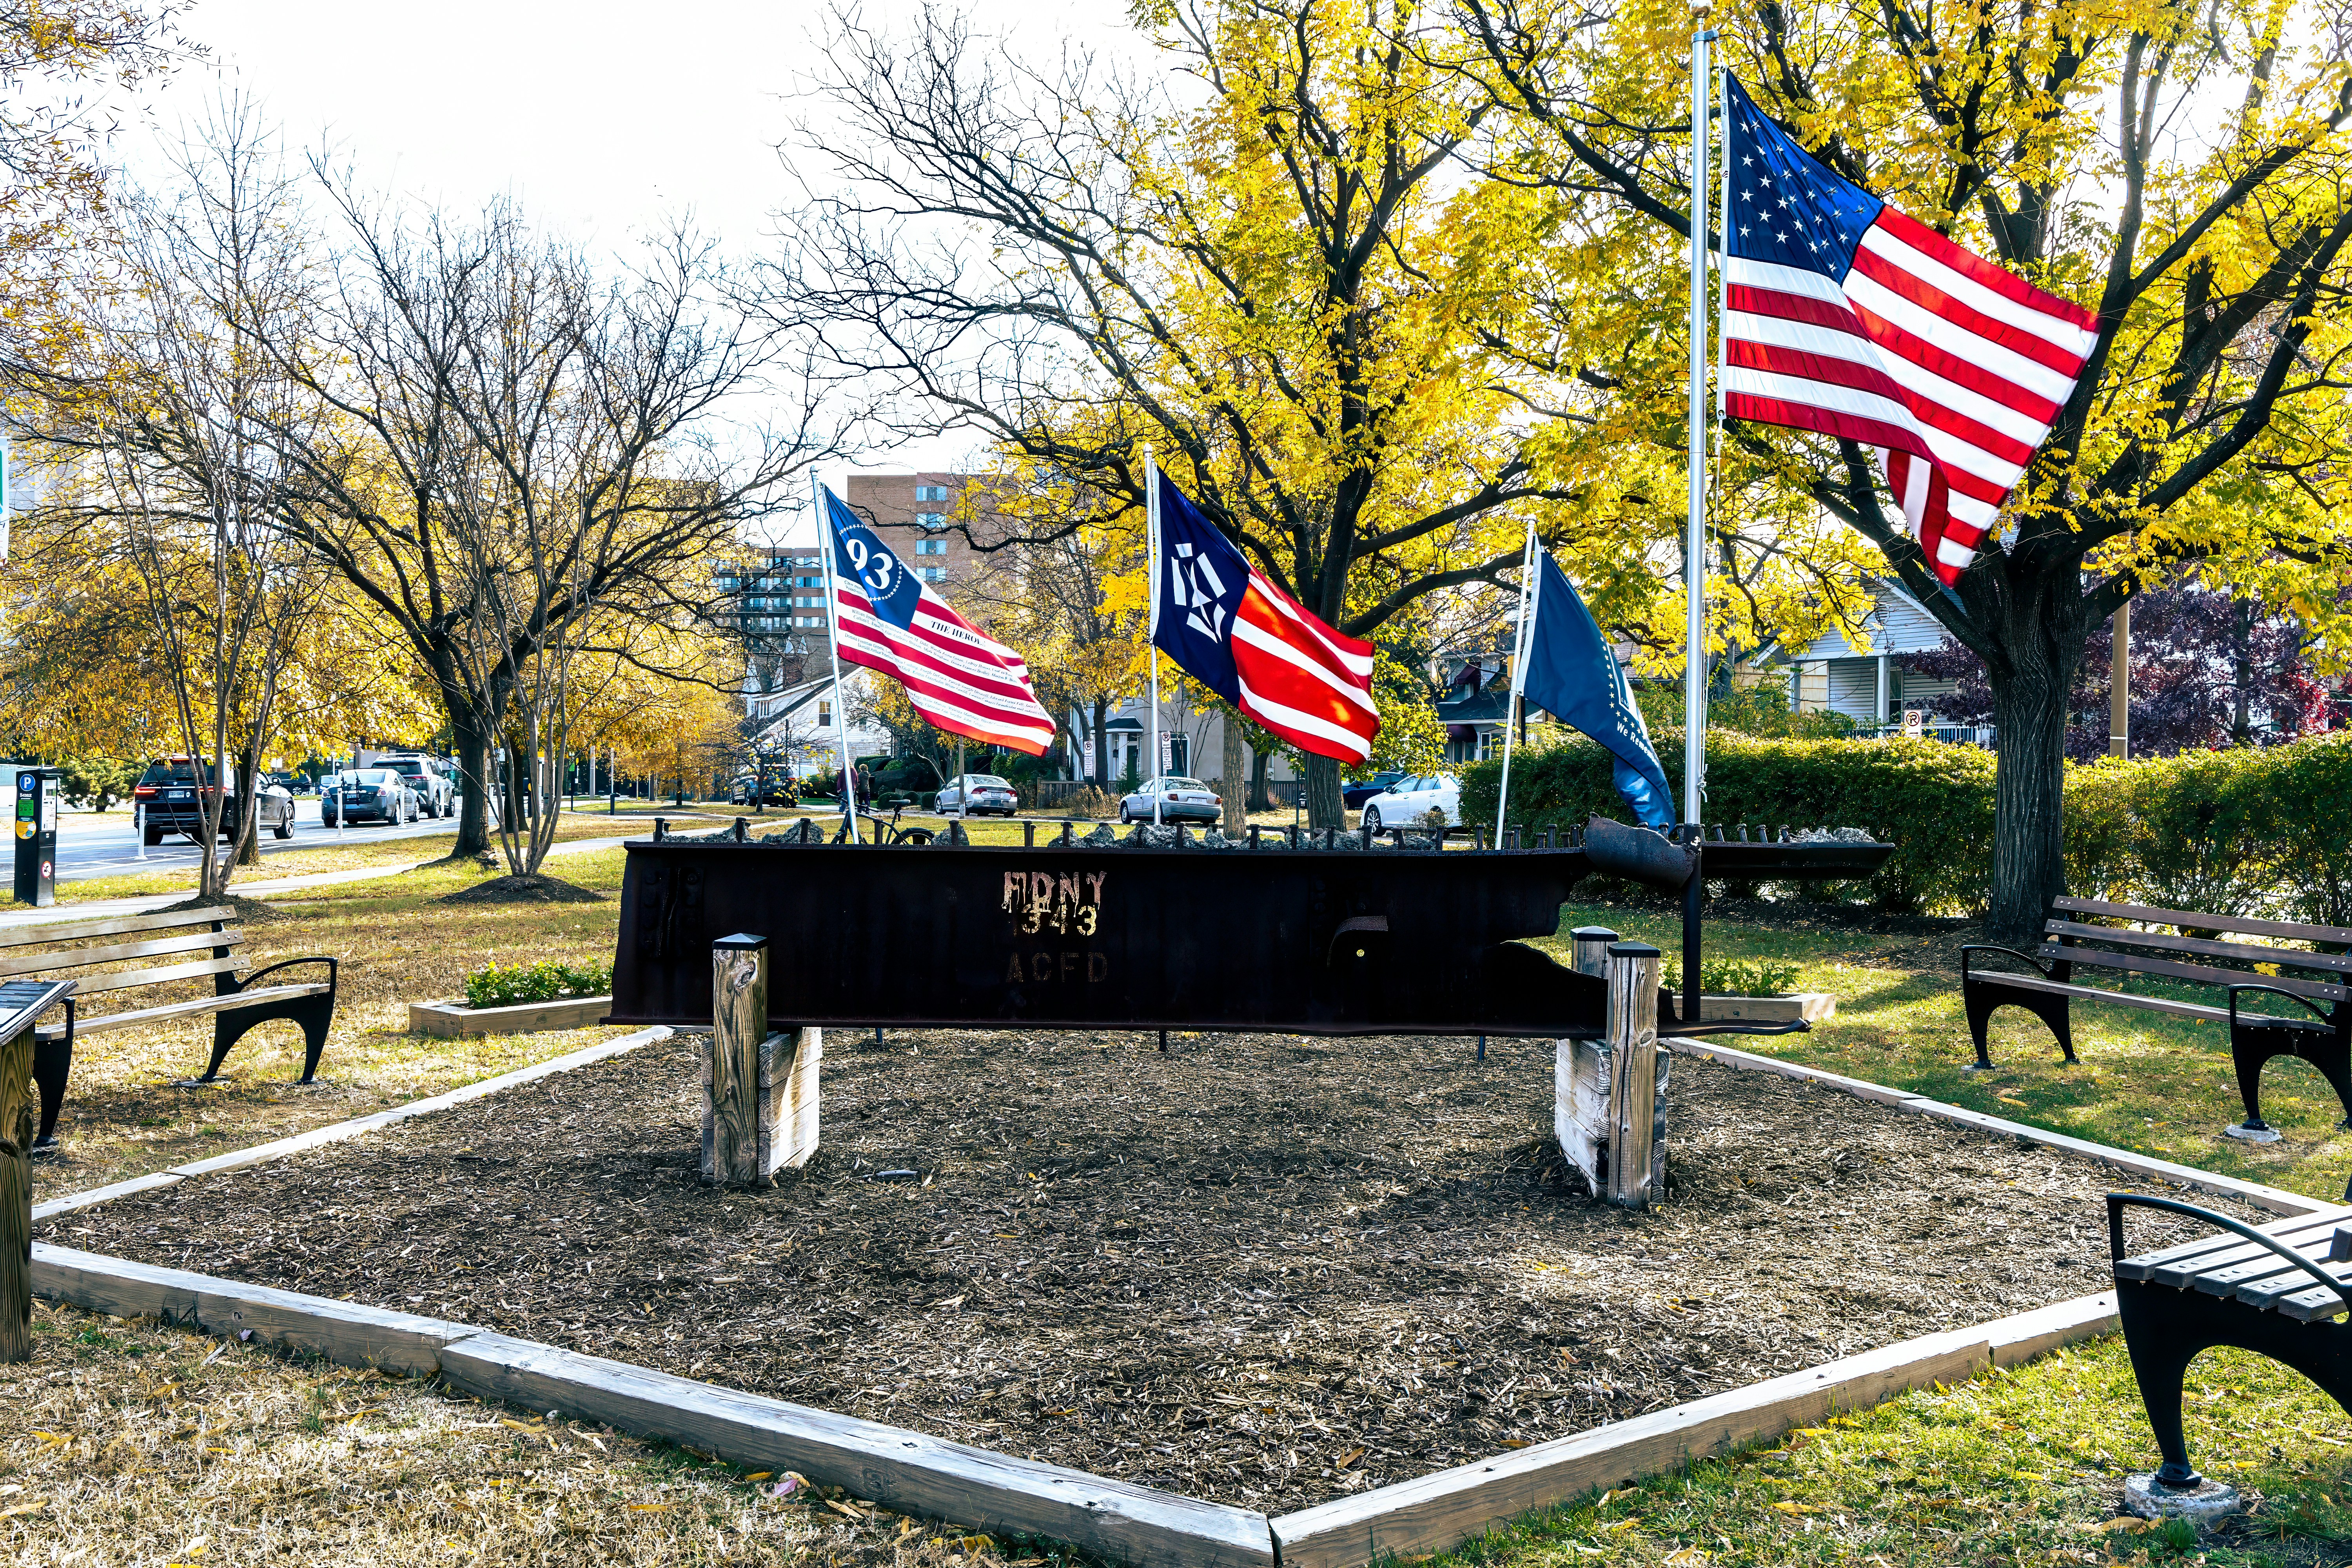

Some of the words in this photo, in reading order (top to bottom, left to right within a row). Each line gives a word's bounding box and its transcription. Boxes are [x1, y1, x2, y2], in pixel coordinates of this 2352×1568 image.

[846, 539, 893, 589] 93
[931, 621, 950, 634] THE
[952, 628, 985, 647] HERO
[1617, 721, 1628, 737] We
[1630, 731, 1659, 768] Reme
[24, 777, 31, 788] P
[1002, 871, 1107, 913] FDNY
[1021, 904, 1097, 936] 343
[1006, 951, 1107, 983] ACFD
